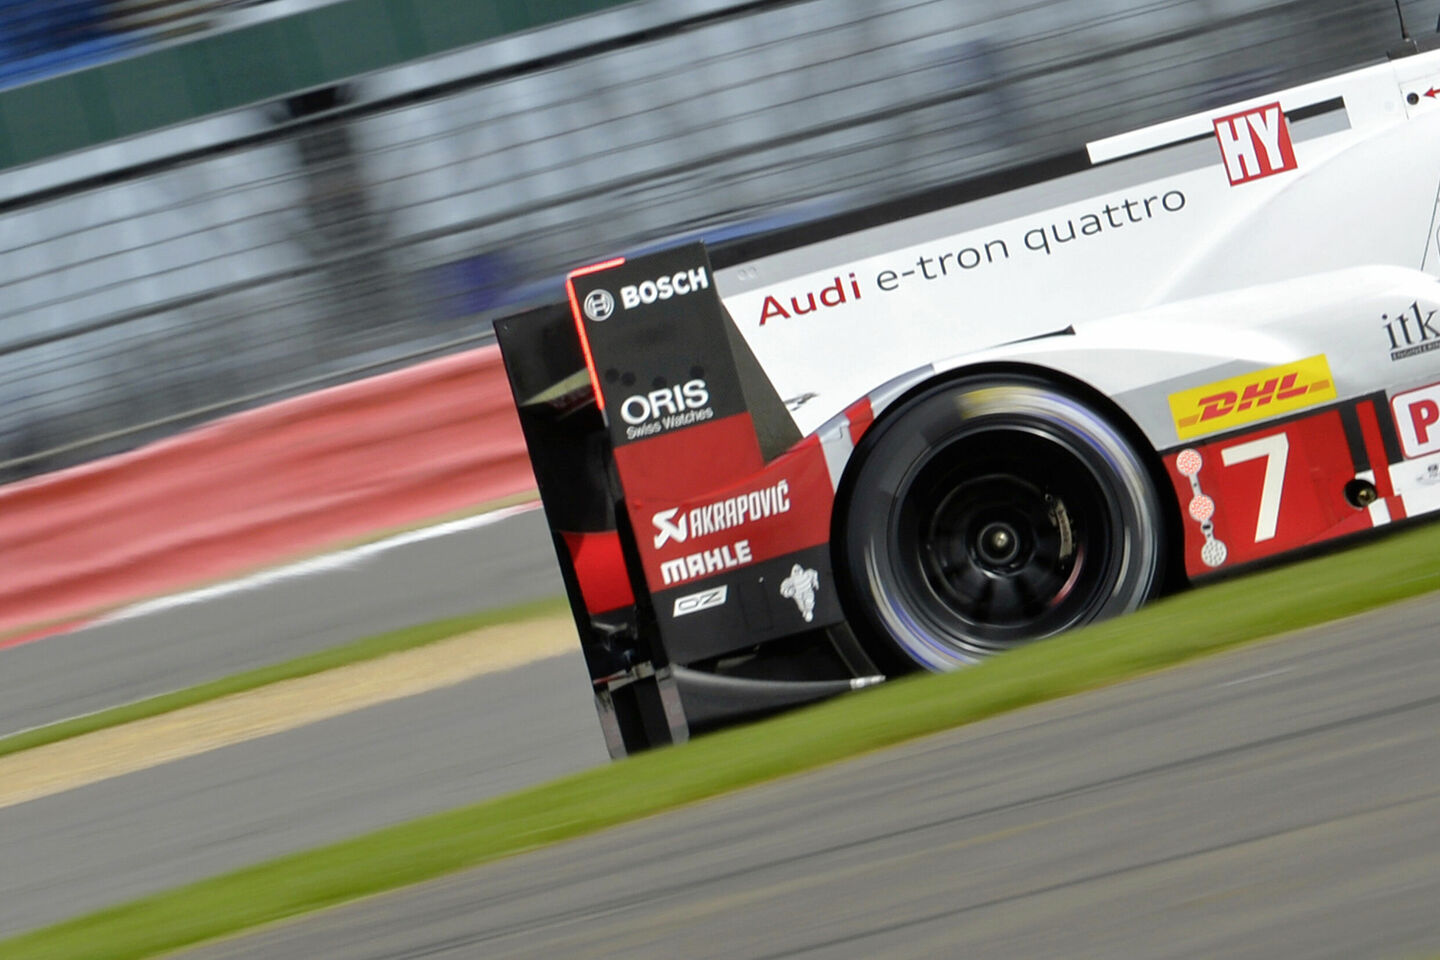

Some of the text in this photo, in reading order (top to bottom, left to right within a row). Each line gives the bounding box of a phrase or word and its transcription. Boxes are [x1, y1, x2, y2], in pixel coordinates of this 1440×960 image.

[1216, 107, 1284, 181] HY
[759, 189, 1186, 326] Audi e-tron quattro
[620, 266, 709, 310] BOSCH
[621, 380, 709, 425] ORIS
[1198, 372, 1309, 422] DHL
[626, 407, 714, 440] Swiss Watches
[689, 479, 790, 539] AKRAPOVIČ
[1221, 432, 1289, 544] 7
[660, 540, 752, 585] MAHLE
